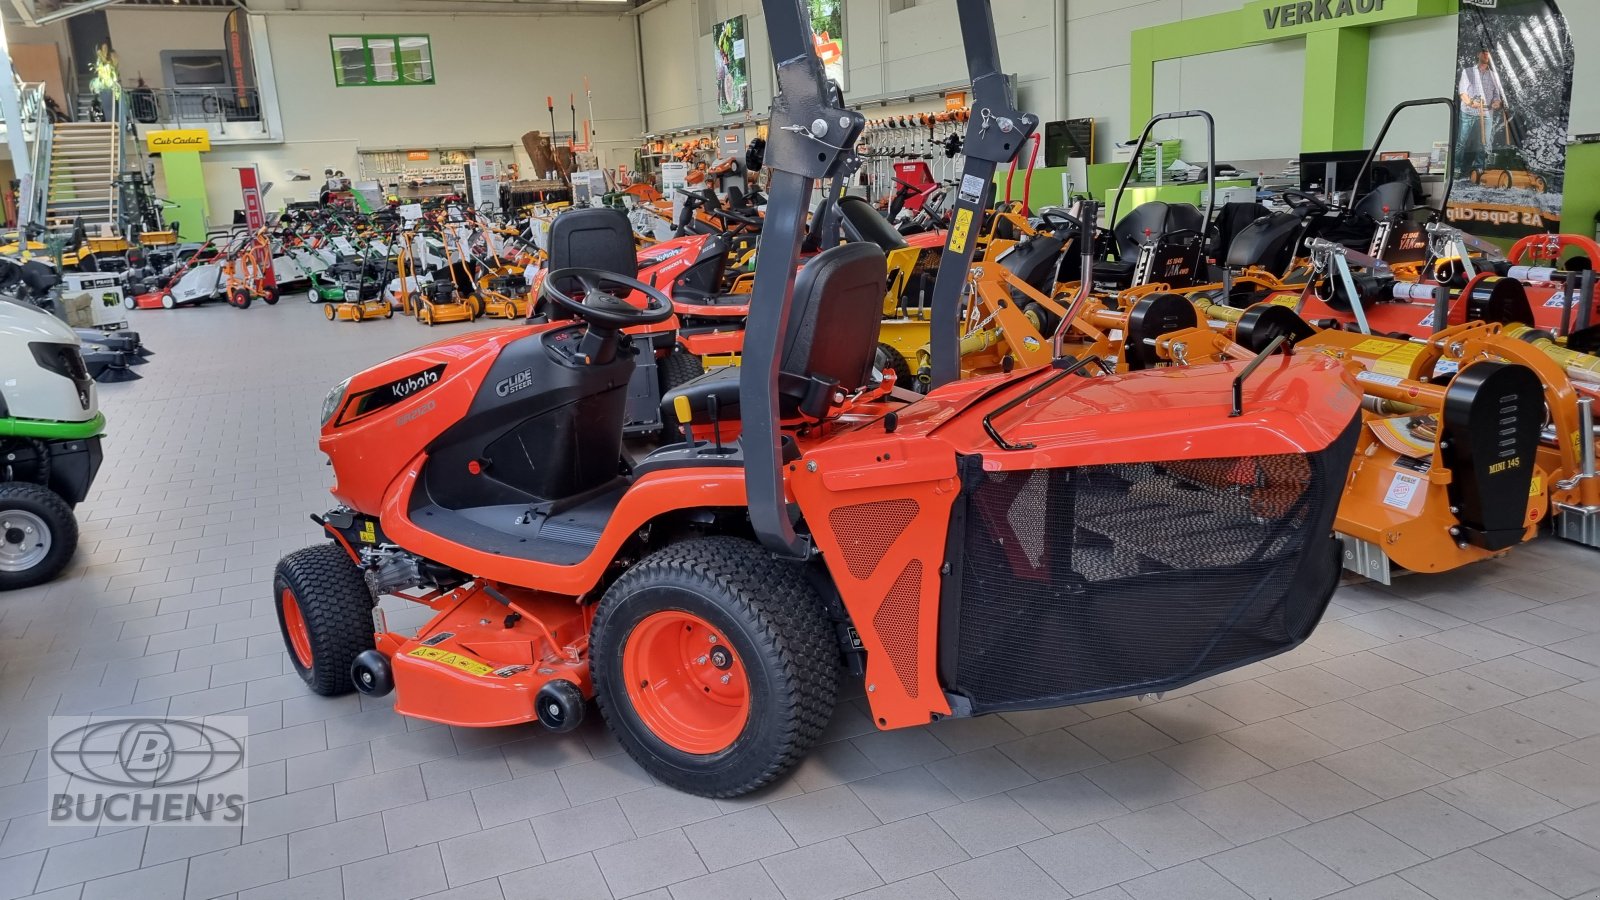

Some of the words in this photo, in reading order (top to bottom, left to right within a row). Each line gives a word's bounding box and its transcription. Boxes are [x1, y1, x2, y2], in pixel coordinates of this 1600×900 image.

[172, 136, 204, 144] Cadet
[1399, 239, 1416, 250] YAK
[392, 371, 438, 397] Kubota
[496, 368, 533, 397] GLIDE
[509, 380, 533, 394] STEER
[1489, 462, 1506, 474] MINI
[1507, 457, 1521, 469] 145
